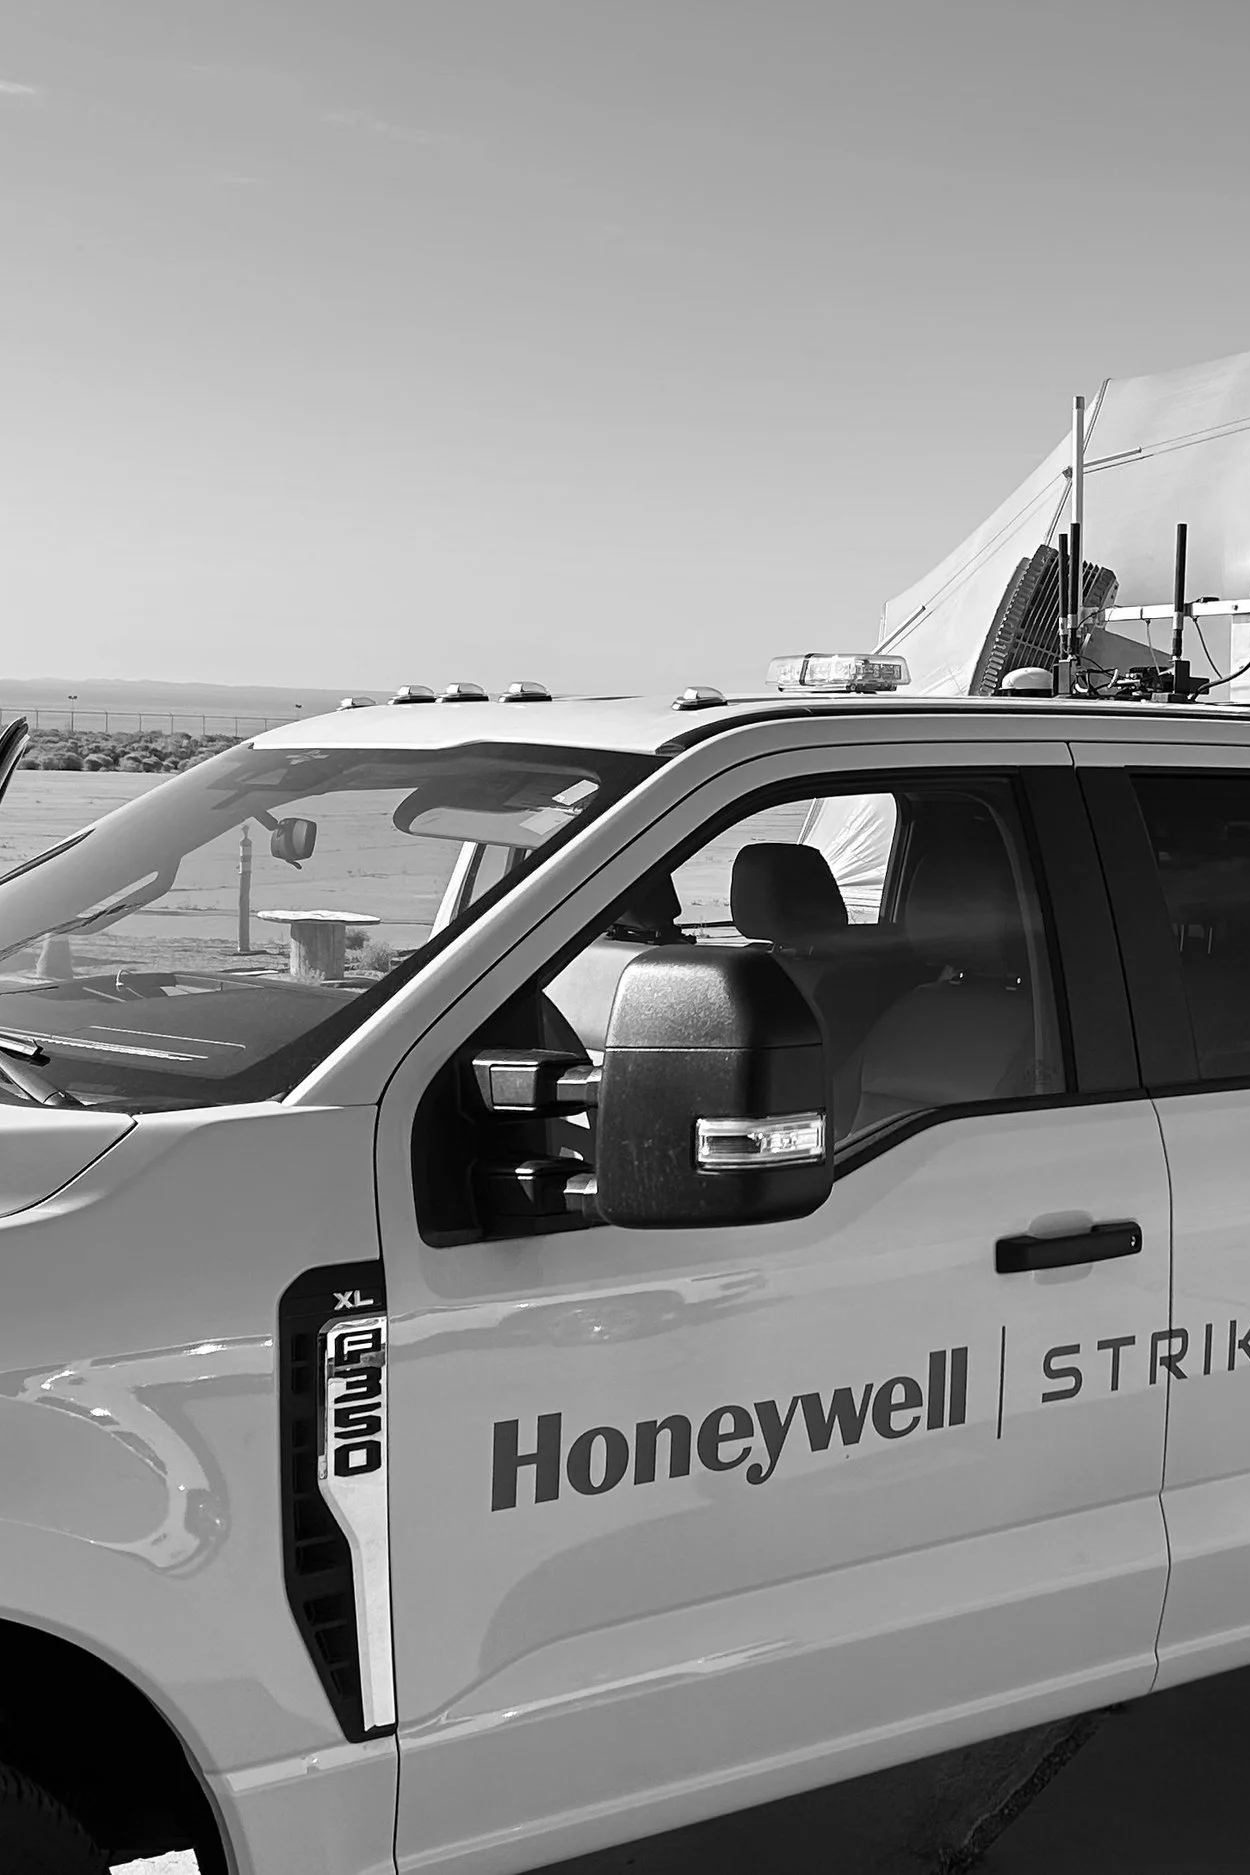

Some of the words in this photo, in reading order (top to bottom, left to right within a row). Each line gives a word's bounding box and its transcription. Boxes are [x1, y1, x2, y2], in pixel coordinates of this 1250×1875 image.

[333, 1290, 374, 1310] XL
[334, 1328, 382, 1477] F350
[491, 1346, 968, 1512] Honeywell
